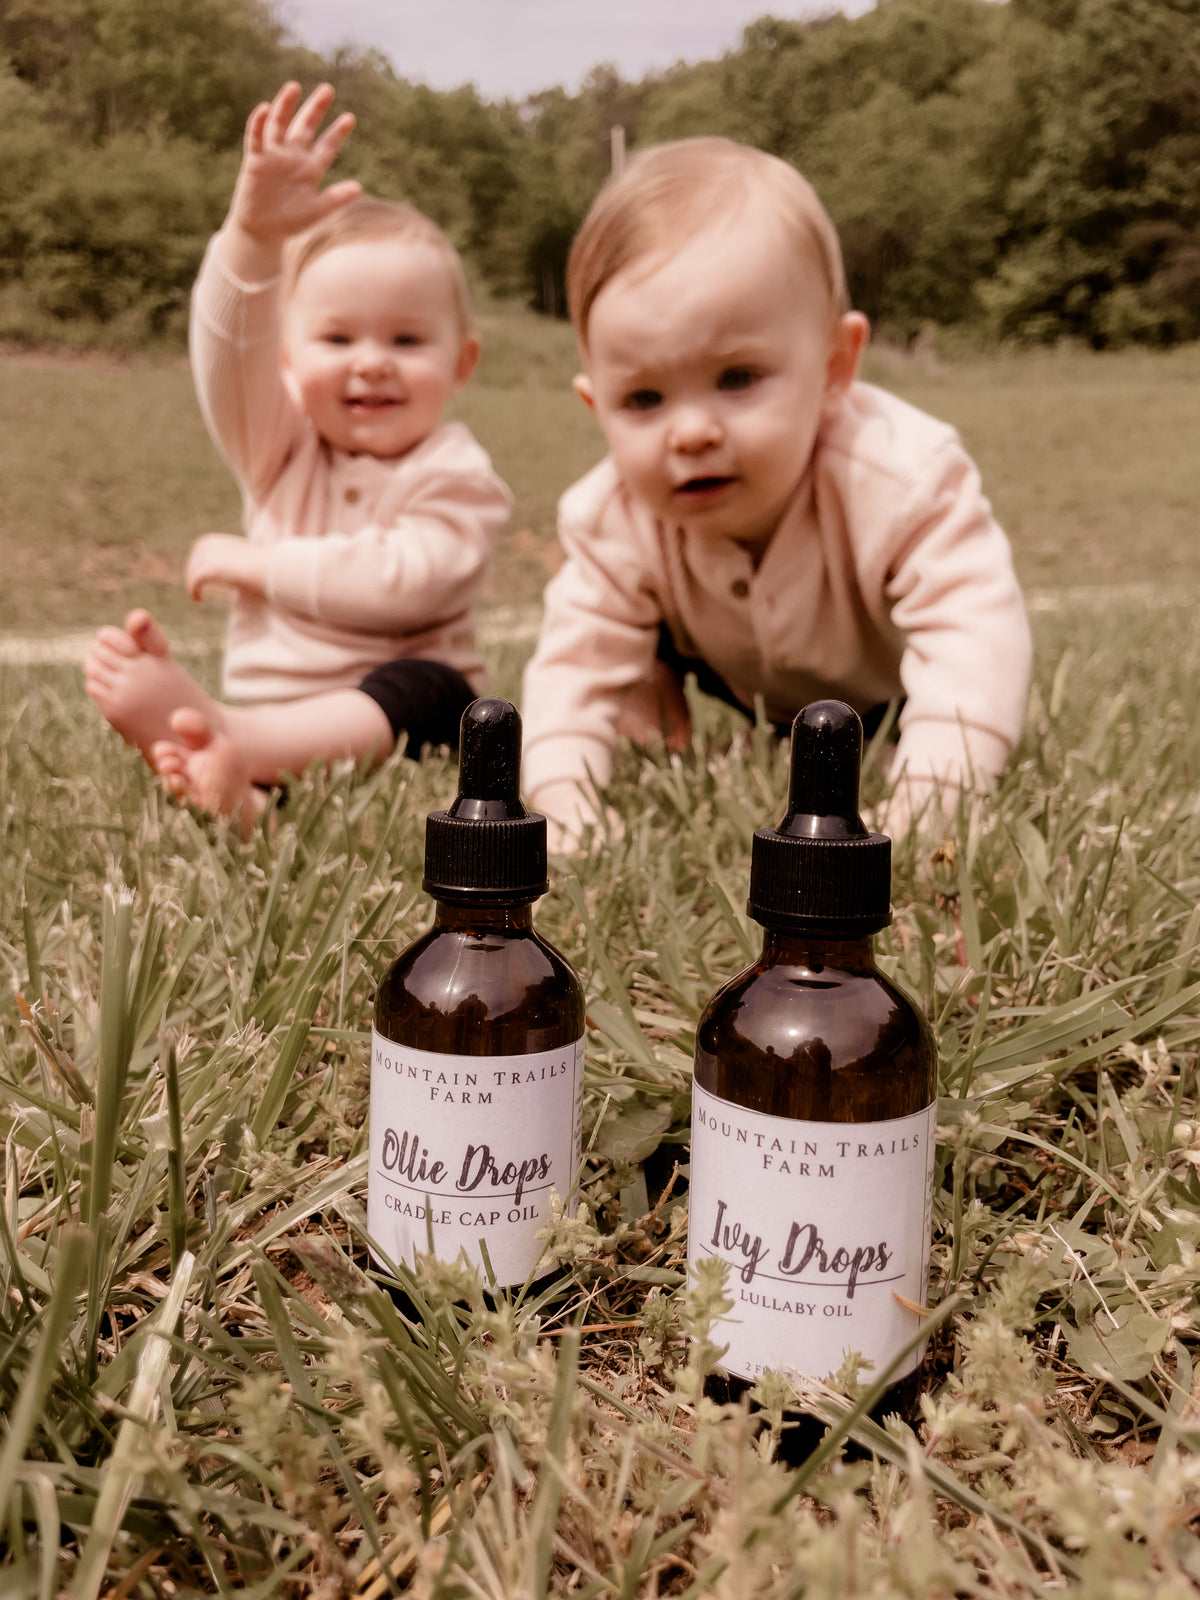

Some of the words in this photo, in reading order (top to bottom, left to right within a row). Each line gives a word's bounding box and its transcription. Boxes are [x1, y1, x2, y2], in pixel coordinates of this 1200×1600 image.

[376, 1049, 477, 1086] MOUNTAIN
[494, 1062, 567, 1086] TRAILS
[430, 1087, 493, 1104] FARM
[699, 1106, 818, 1155] MOUNTAIN
[837, 1133, 919, 1158] TRAILS
[382, 1128, 448, 1184] Ollie
[455, 1144, 552, 1206] Drops
[762, 1154, 835, 1178] FARM
[459, 1211, 500, 1226] CAP
[507, 1205, 539, 1223] OIL
[711, 1200, 770, 1284] Ivy
[778, 1221, 893, 1299] Drops
[740, 1288, 816, 1316] LULLABY
[823, 1304, 853, 1316] OIL
